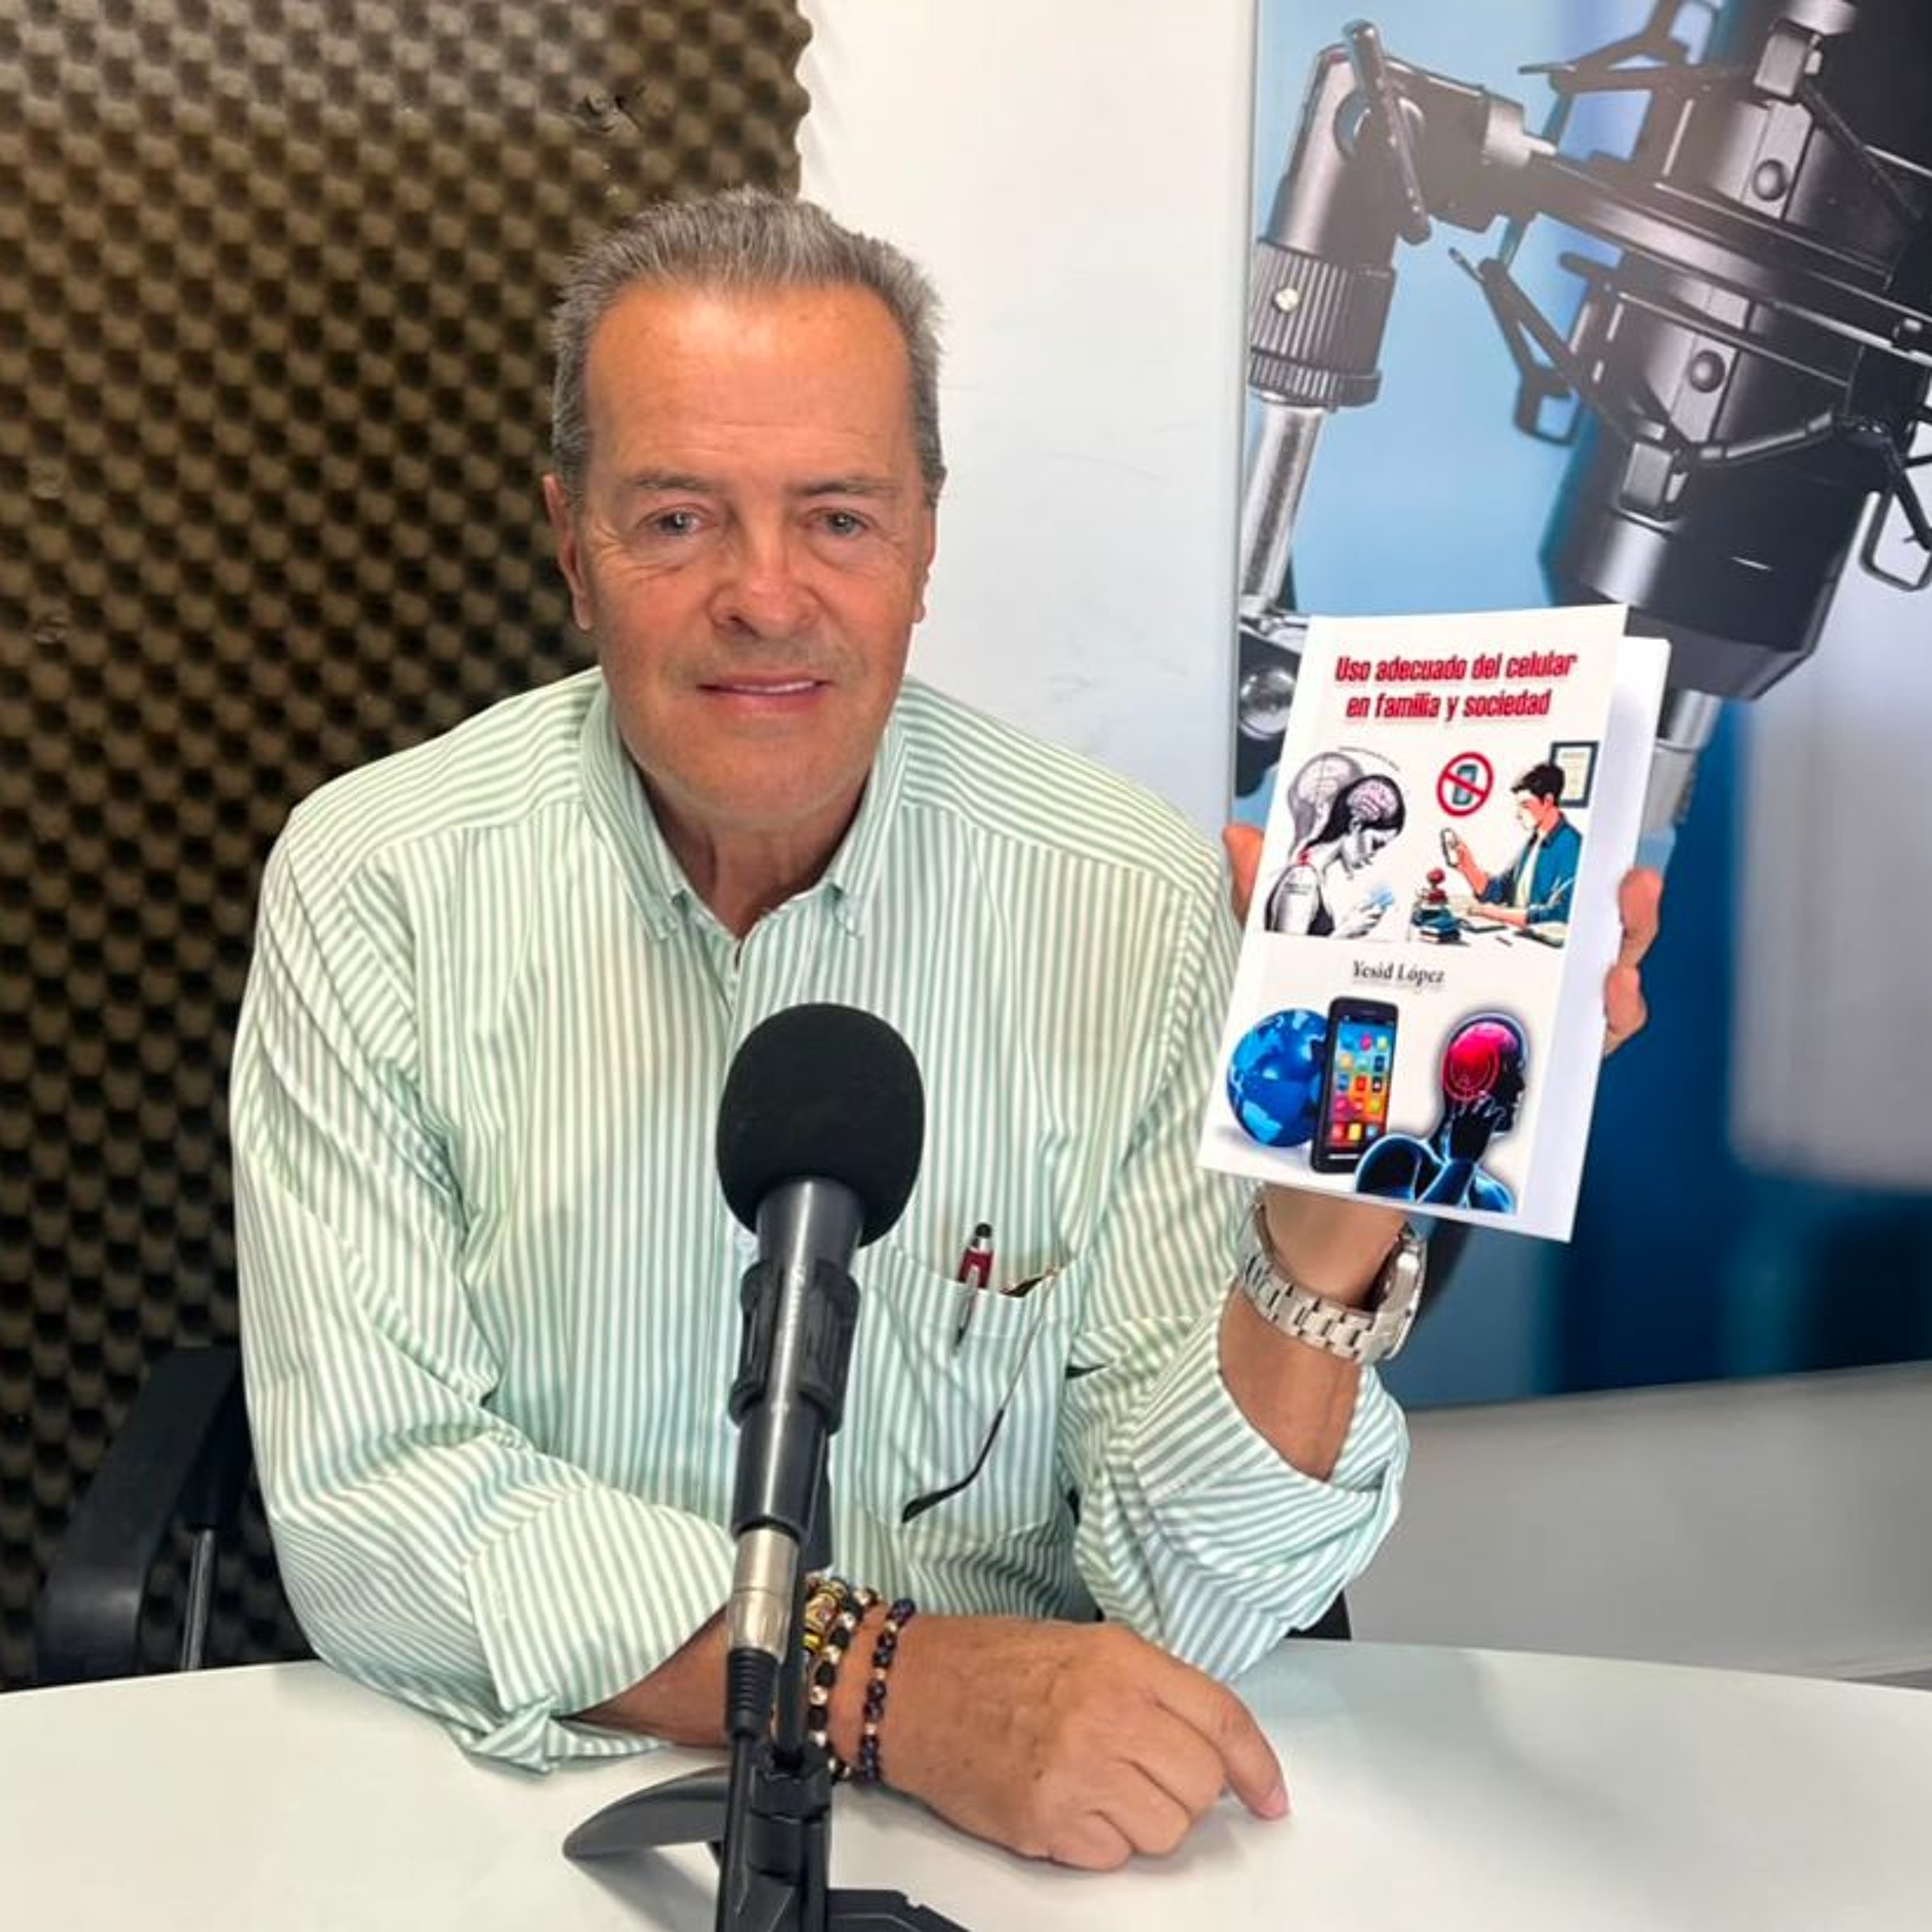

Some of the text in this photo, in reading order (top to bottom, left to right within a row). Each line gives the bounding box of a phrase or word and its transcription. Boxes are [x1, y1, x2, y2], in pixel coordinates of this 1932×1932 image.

[1335, 650, 1578, 682] Uso adecuado del celular
[1346, 688, 1553, 722] en familia y sociedad
[1353, 960, 1445, 987] Yesid López
